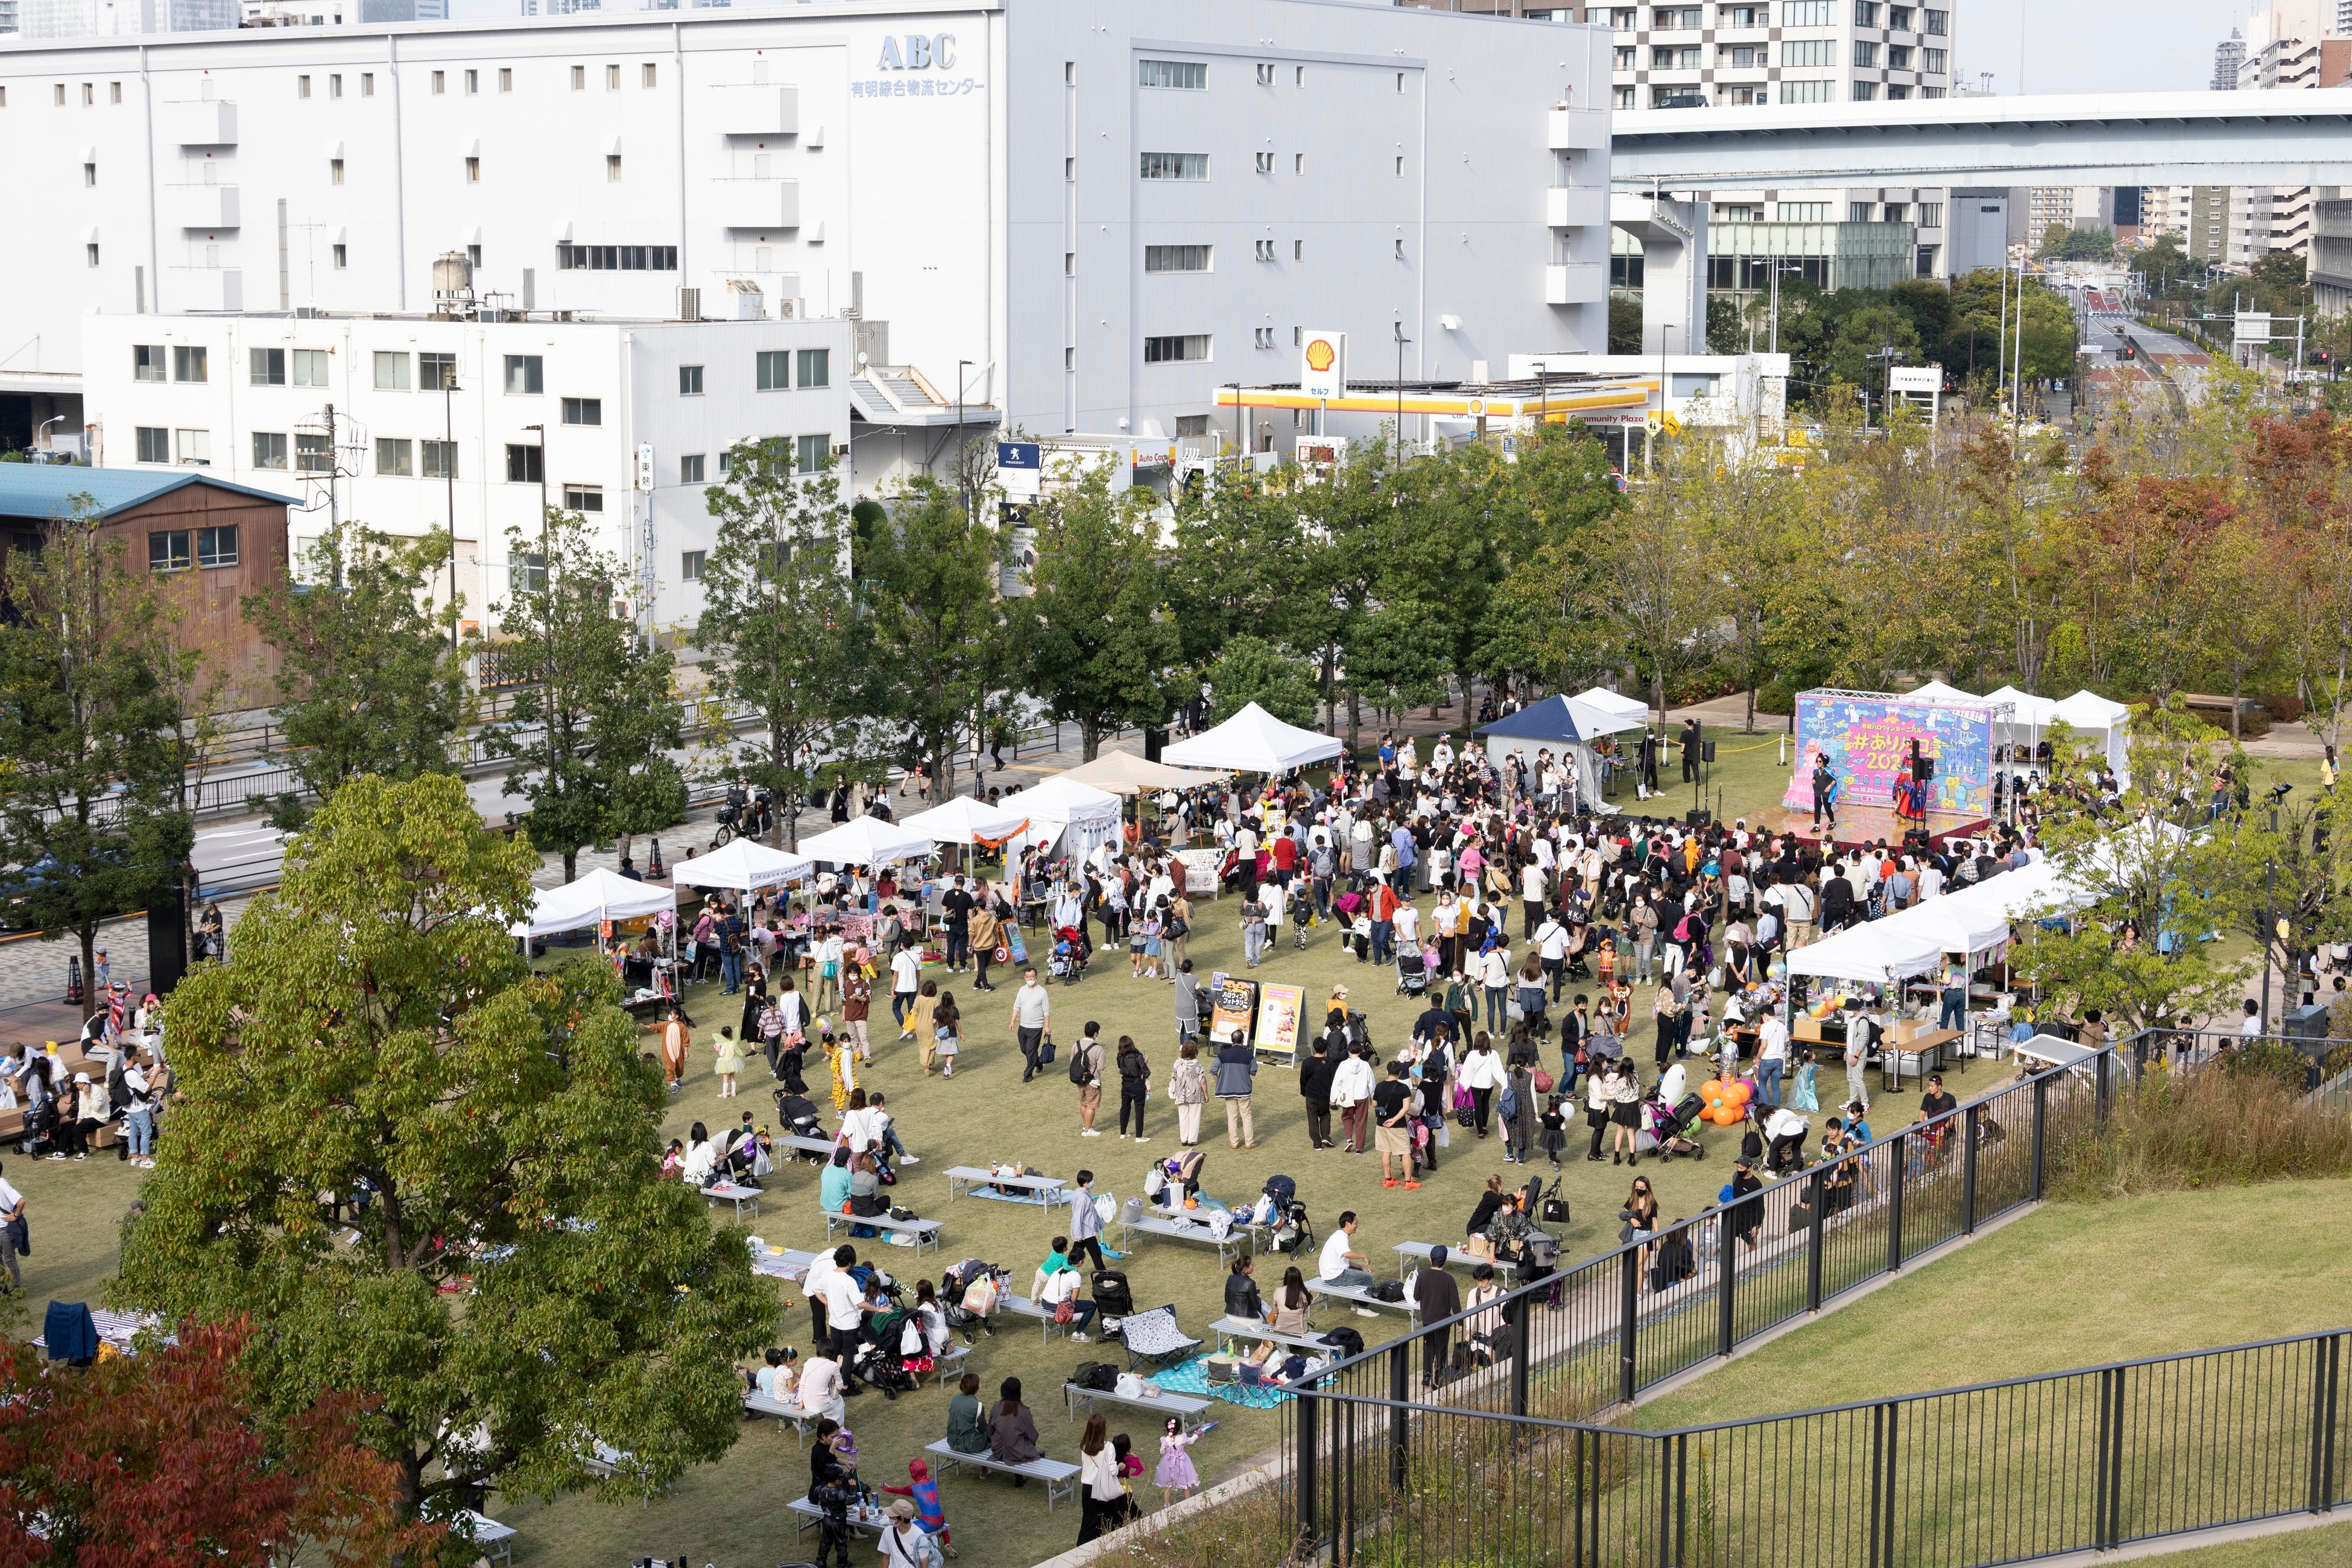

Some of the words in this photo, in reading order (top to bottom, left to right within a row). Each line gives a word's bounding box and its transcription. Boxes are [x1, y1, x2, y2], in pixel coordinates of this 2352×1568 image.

[876, 33, 956, 71] ABC
[851, 78, 985, 97] 有明綜合物流センター
[1310, 387, 1329, 396] セルフ
[1570, 414, 1618, 423] mmunity
[642, 462, 650, 484] 東熱
[1862, 724, 1923, 733] 有明ハロウィンカーニバル
[1866, 752, 1902, 771] 202
